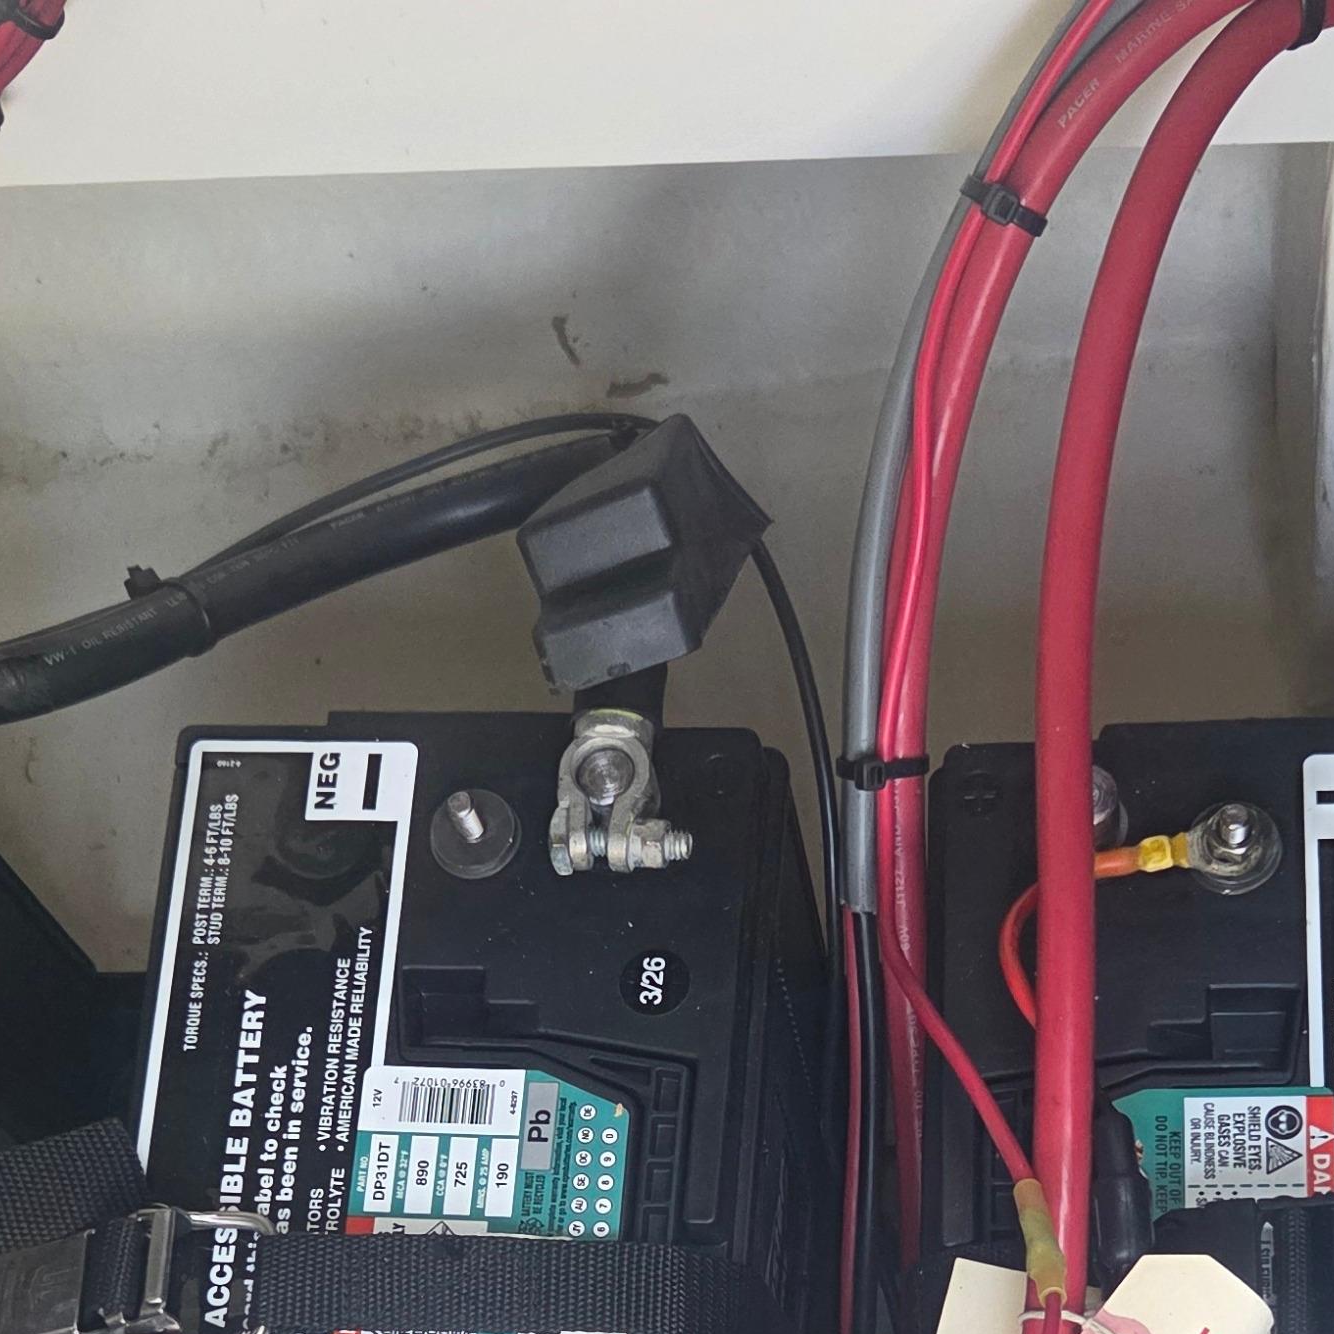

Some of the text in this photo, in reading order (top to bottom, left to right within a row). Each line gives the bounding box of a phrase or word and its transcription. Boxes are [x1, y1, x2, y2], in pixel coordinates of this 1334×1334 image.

[313, 751, 342, 810] NEG
[205, 792, 240, 945] STUD FT/LBS
[182, 802, 224, 1051] TORQUE POST FT/LBS
[638, 956, 666, 1005] 3/26
[228, 988, 267, 1127] BATTERY
[315, 956, 351, 1141] VIBRATION RESISTANCE
[334, 925, 373, 1143] AMERICAN MADE RELIABILITY
[263, 1064, 288, 1132] check
[274, 1145, 299, 1201] been
[289, 1025, 313, 1113] service.
[371, 1087, 383, 1108] 12V
[526, 1108, 552, 1143] Pb
[259, 1137, 279, 1162] to
[1167, 1130, 1182, 1160] KEEP
[1202, 1101, 1217, 1180] CAUSE BLINDNESS
[1216, 1113, 1231, 1148] GASES
[1231, 1111, 1247, 1169] EXPLOSIVE
[1246, 1105, 1263, 1171] SHIELD EYES.
[371, 1140, 391, 1201] DP31DT
[414, 1158, 430, 1186] 890
[453, 1160, 469, 1188] 725
[494, 1161, 510, 1188] 190
